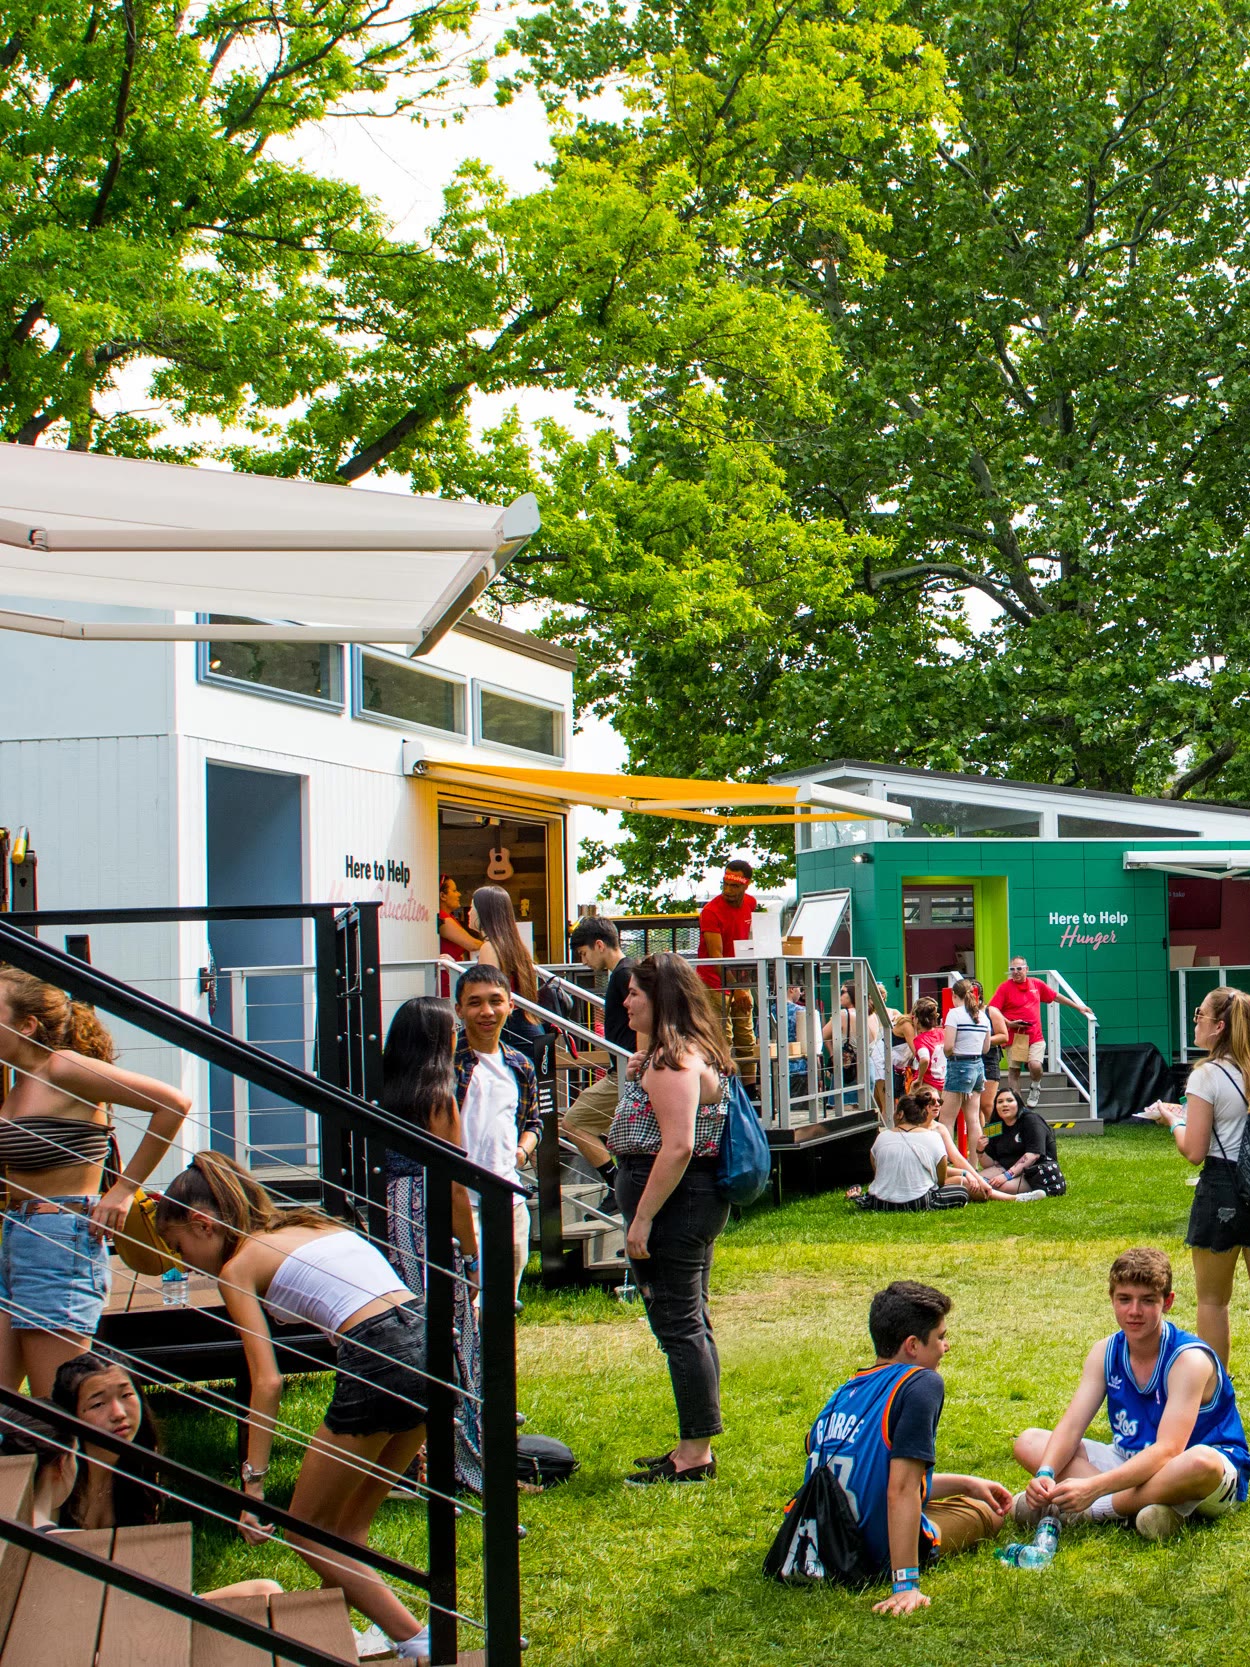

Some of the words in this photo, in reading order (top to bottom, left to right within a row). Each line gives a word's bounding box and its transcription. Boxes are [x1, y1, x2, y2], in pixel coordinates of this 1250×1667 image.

[345, 855, 371, 880] Here
[374, 861, 385, 881] to
[388, 860, 411, 888] Help
[1049, 912, 1080, 925] Here
[1082, 912, 1096, 924] to
[1099, 911, 1128, 926] Help
[1060, 924, 1117, 951] Hunger
[1112, 1409, 1138, 1437] Los
